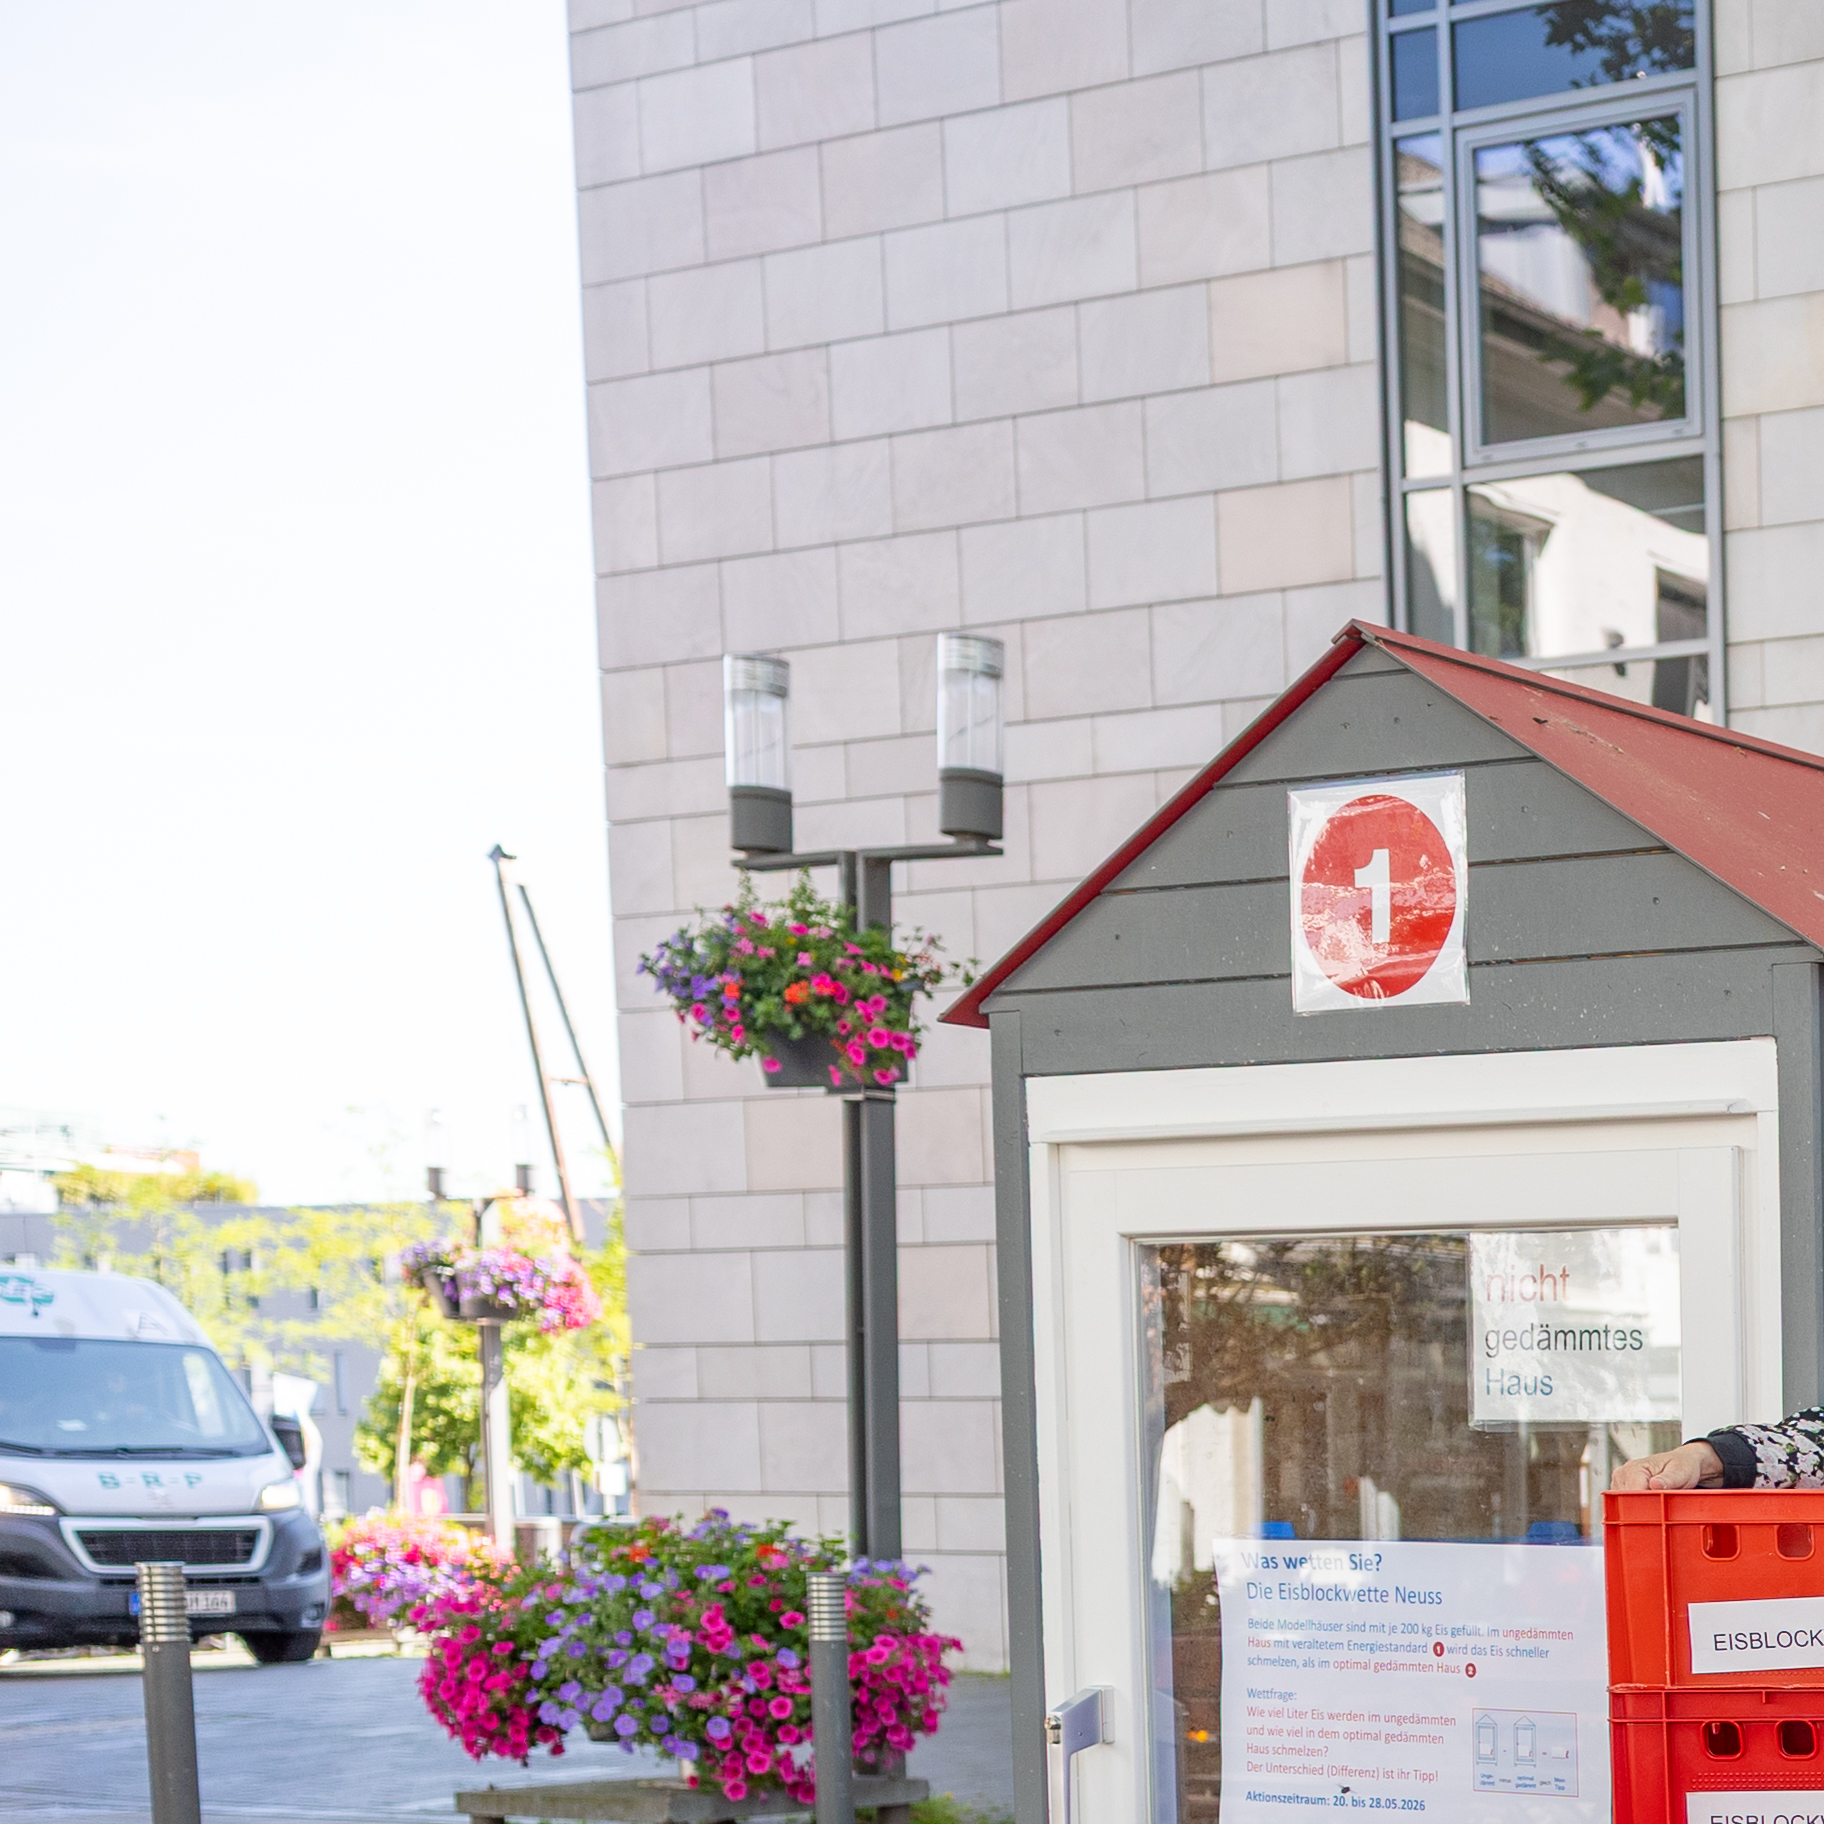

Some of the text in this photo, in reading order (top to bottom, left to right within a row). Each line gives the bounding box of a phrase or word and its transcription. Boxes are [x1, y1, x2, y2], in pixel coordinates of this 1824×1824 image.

[1354, 848, 1390, 943] 1
[1485, 1264, 1570, 1302] nicht
[1485, 1323, 1643, 1358] gedämmtes
[1486, 1368, 1553, 1396] Haus
[1349, 1553, 1383, 1572] Sie?
[1246, 1581, 1443, 1605] Die Eisblockwette Neuss
[1245, 1790, 1426, 1812] Aktionszeitraum: 20. bis 28.05.2026
